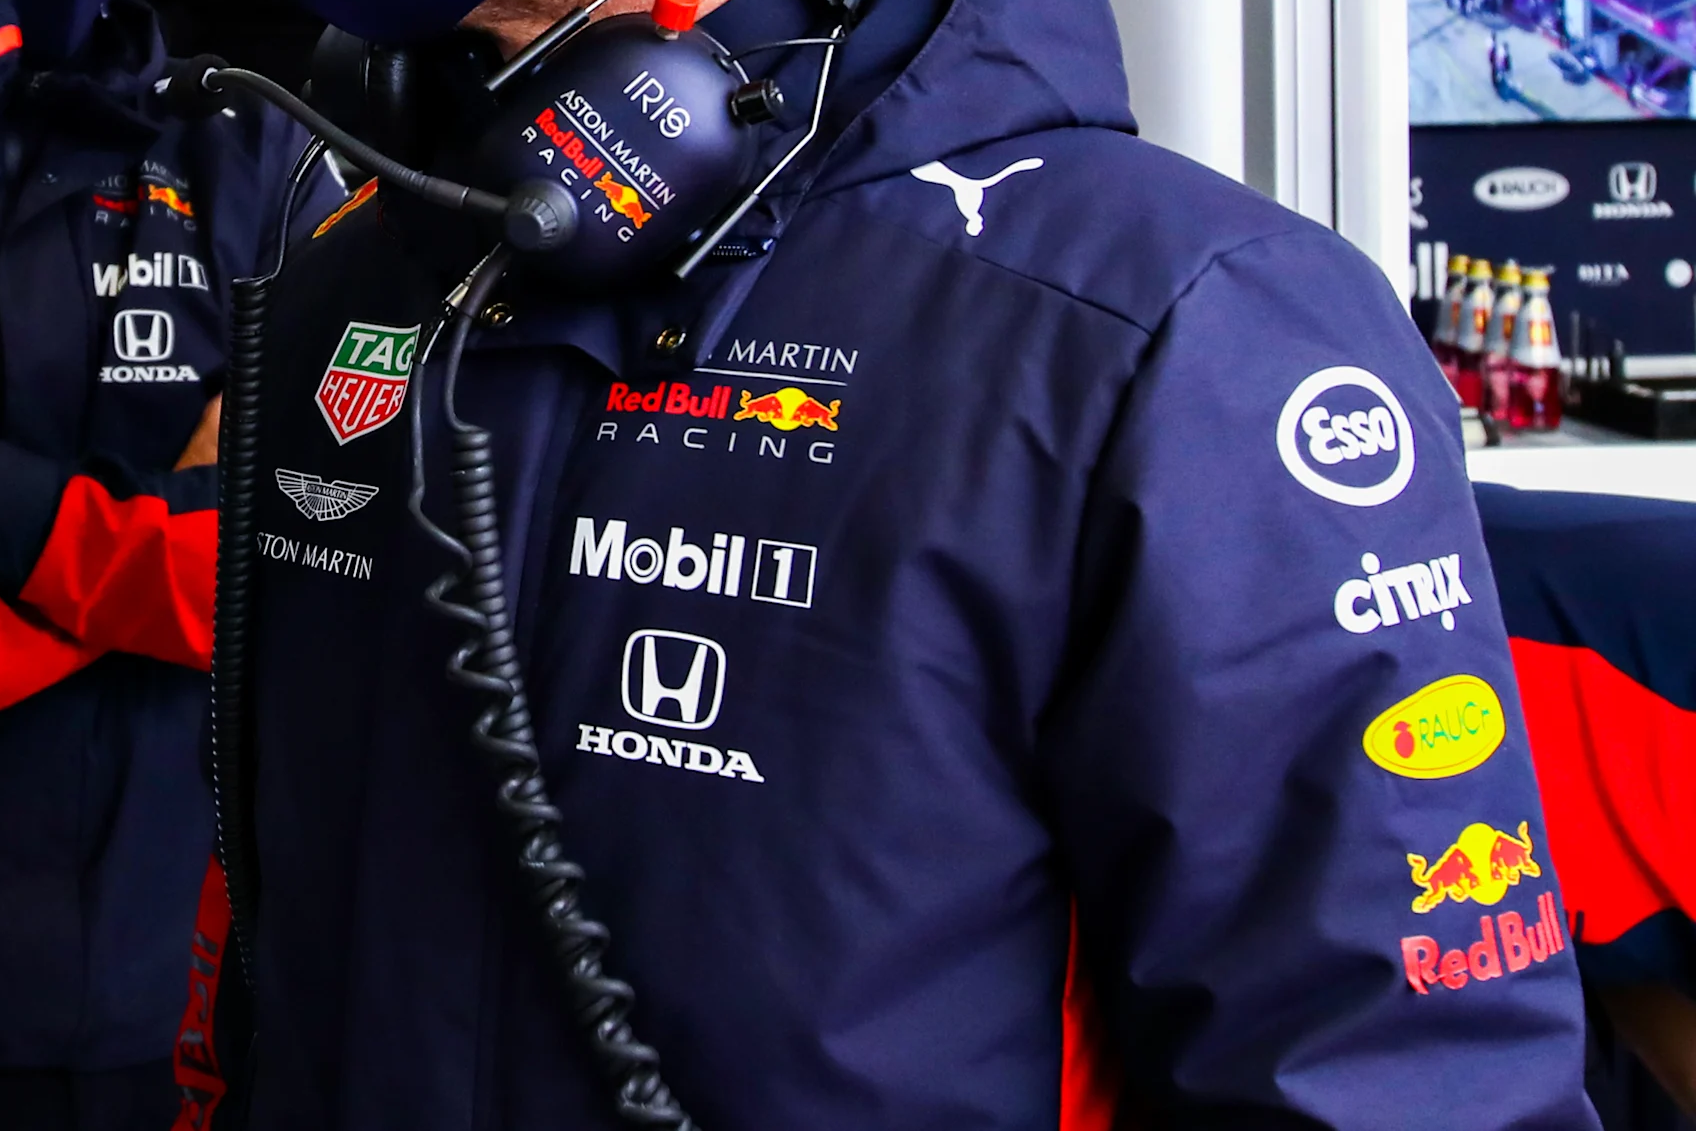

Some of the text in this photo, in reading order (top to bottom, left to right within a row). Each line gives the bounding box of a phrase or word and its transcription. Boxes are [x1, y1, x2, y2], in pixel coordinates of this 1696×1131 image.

[623, 71, 691, 139] IRIS
[535, 106, 605, 179] Red Bull
[559, 89, 675, 206] ASTON MARTIN
[521, 128, 635, 243] RACING
[348, 331, 416, 372] TAG
[727, 338, 858, 375] MARTIN
[323, 374, 404, 434] HEUER
[606, 381, 731, 420] Red Bull
[597, 421, 835, 465] RACING
[257, 531, 373, 581] STON MARTIN
[569, 516, 746, 598] Mobil
[576, 723, 765, 784] HONDA
[1401, 892, 1565, 995] Red Bull
